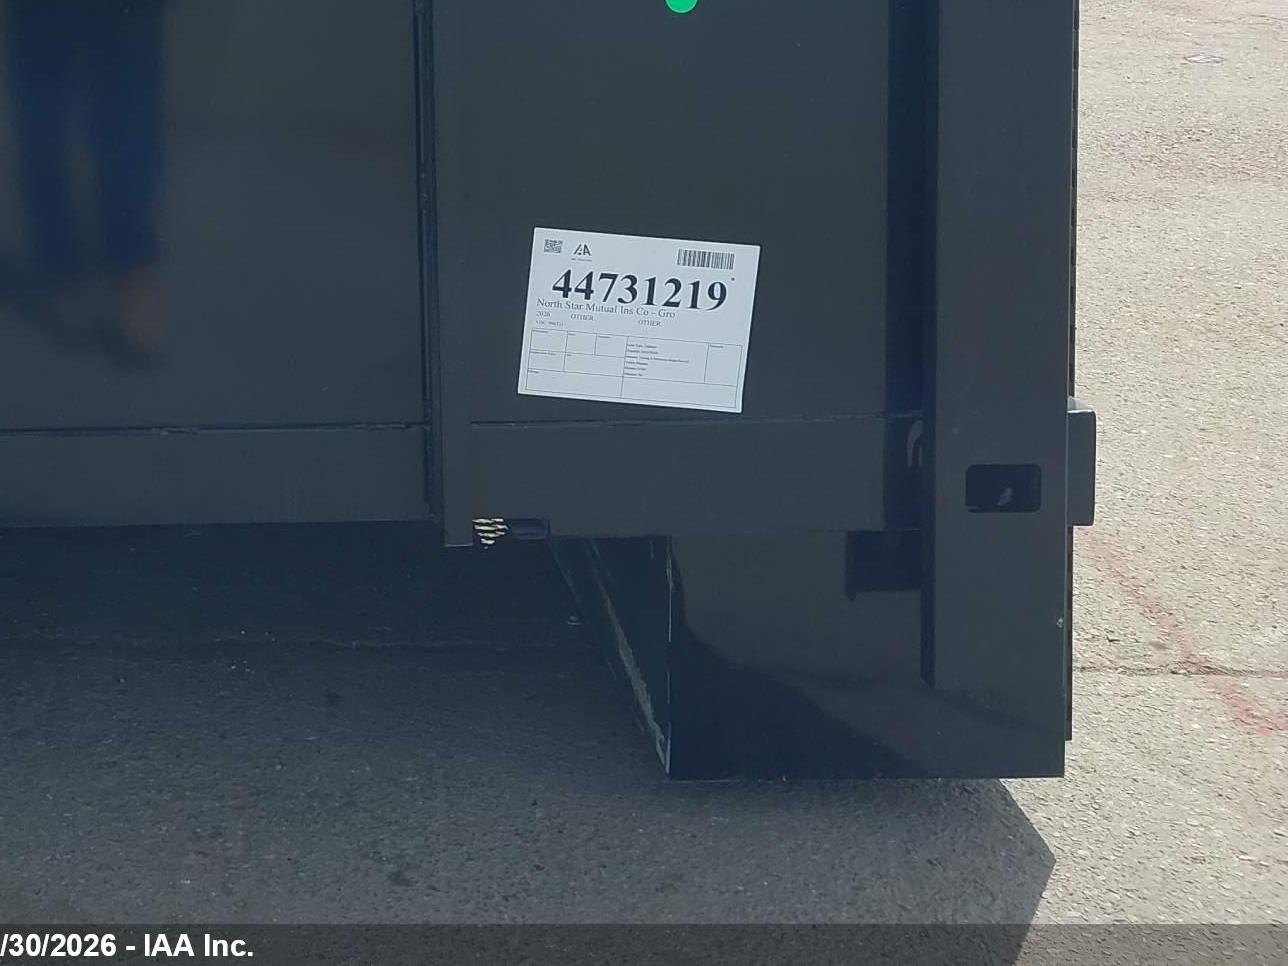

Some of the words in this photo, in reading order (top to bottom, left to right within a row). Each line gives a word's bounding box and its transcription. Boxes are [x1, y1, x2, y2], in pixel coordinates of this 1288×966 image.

[552, 268, 728, 311] 44731219
[536, 297, 563, 309] North
[564, 300, 583, 311] Star
[585, 302, 618, 314] Mutual
[620, 305, 634, 315] Ins
[636, 307, 649, 317] Co
[657, 308, 676, 319] Gro
[570, 313, 594, 322] OTHER
[637, 319, 661, 328] OTHER
